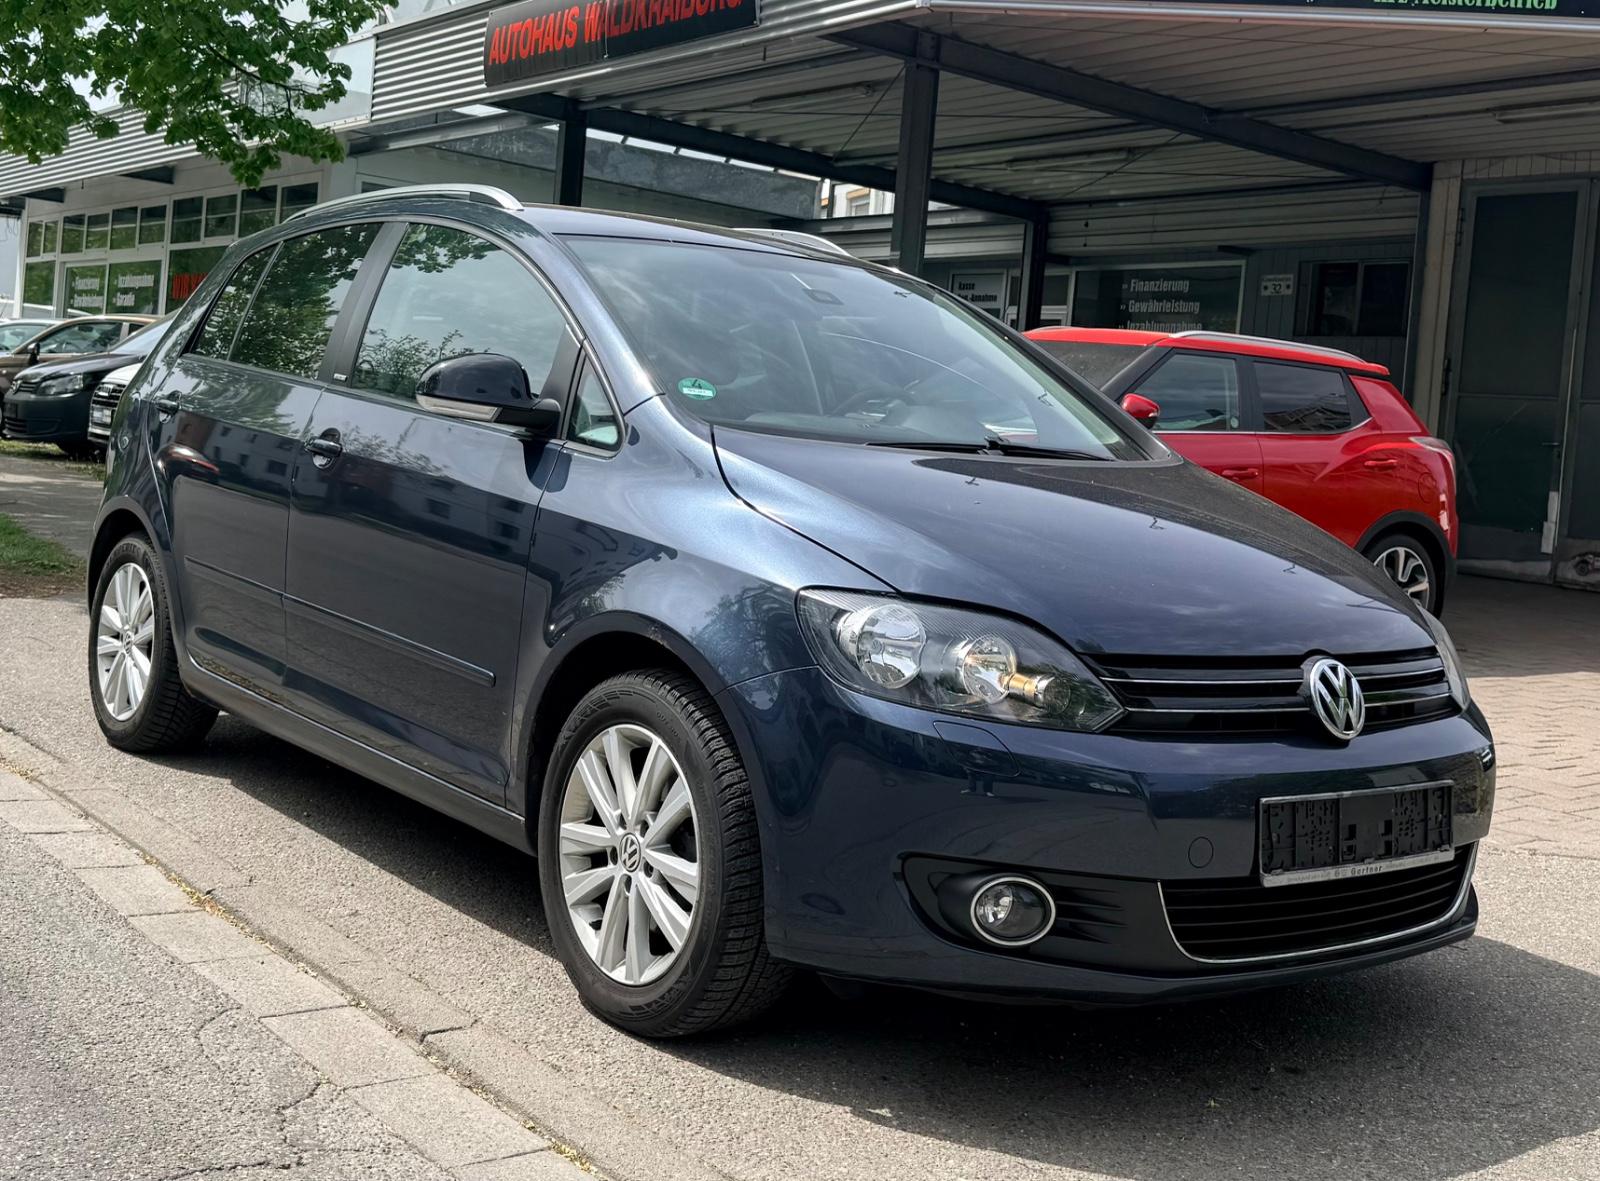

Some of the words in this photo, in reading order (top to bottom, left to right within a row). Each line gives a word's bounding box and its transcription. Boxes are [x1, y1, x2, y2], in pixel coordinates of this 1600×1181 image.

[488, 5, 580, 65] AUTOHAUS
[1129, 278, 1189, 293] Finanzierung
[1128, 299, 1200, 314] Gewährleistung
